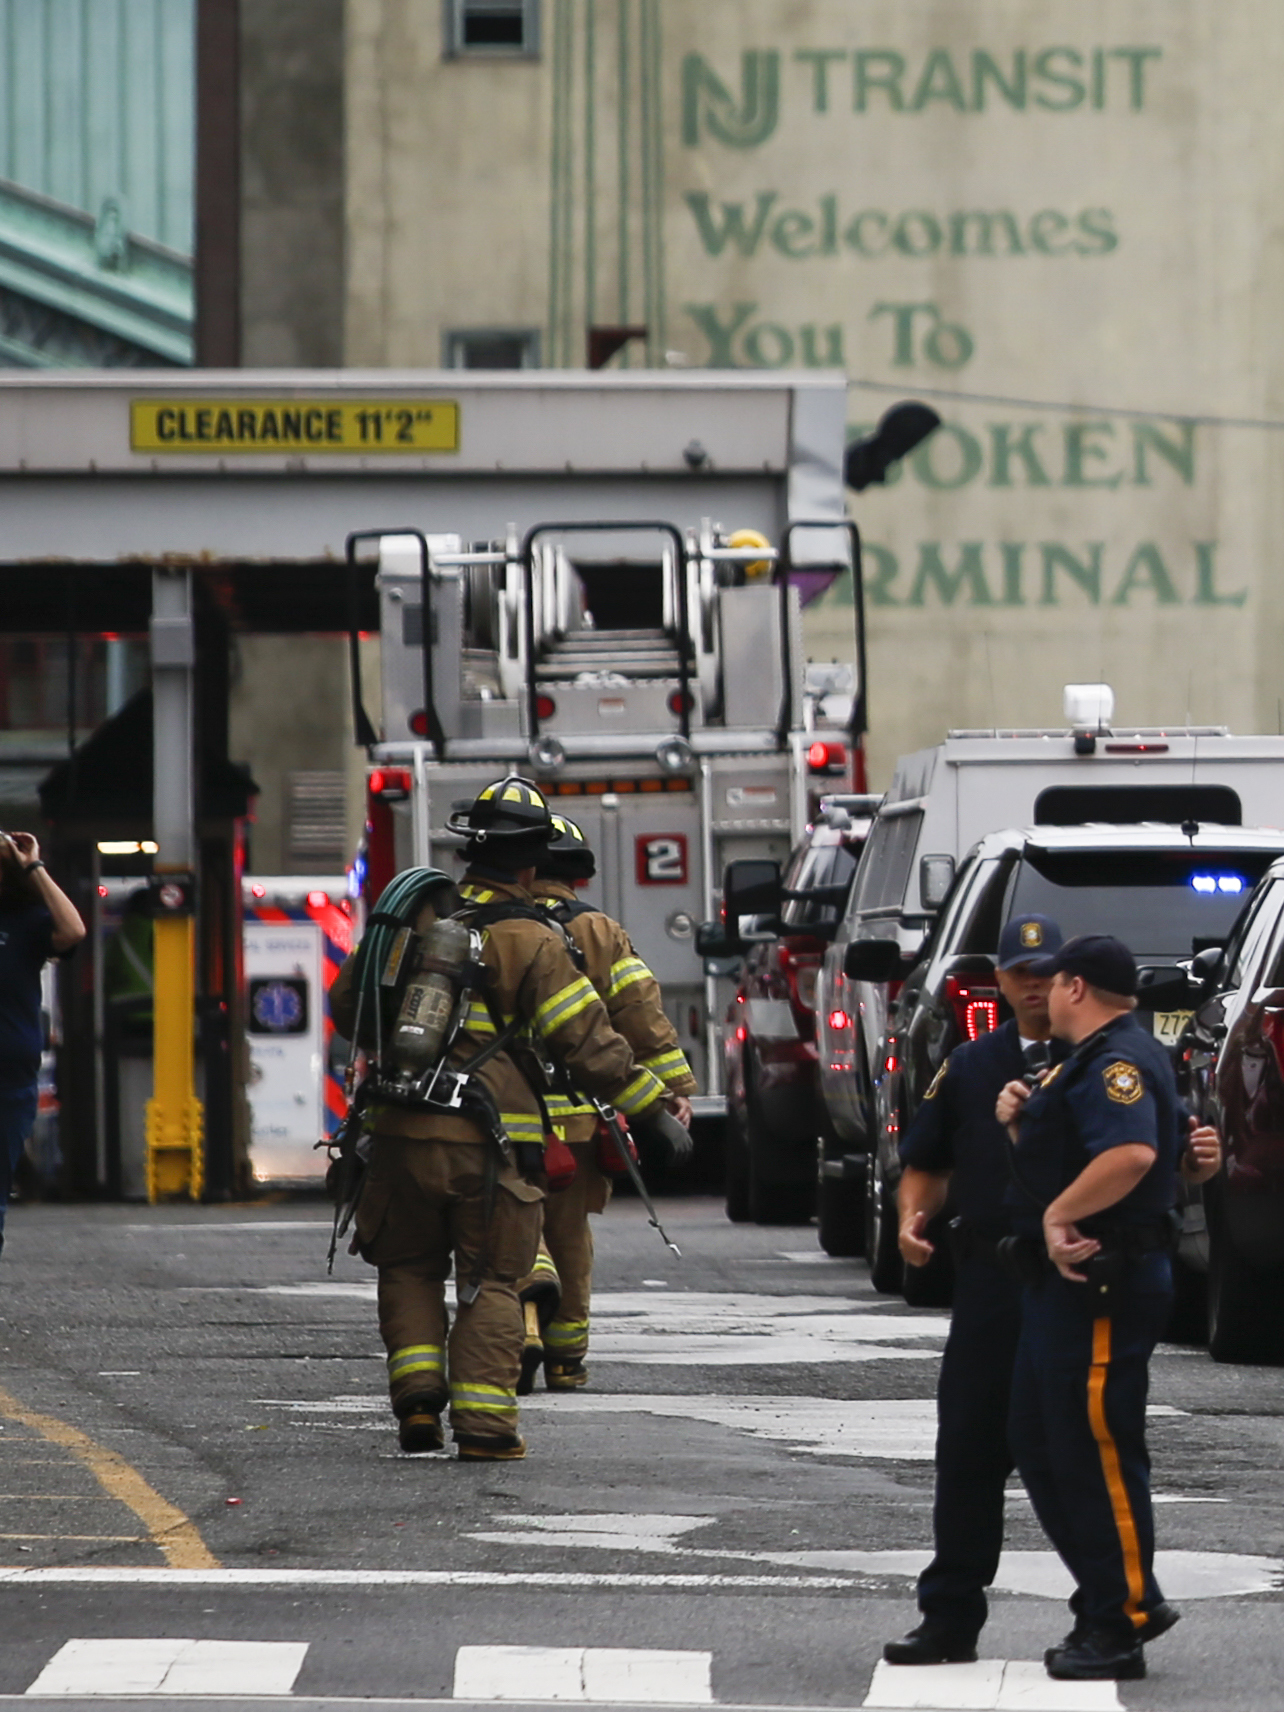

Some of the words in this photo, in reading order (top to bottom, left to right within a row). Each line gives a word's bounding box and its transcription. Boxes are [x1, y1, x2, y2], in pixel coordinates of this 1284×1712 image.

[681, 47, 781, 150] NJ
[793, 46, 1163, 114] TRANSIT
[682, 189, 1120, 259] Welcomes
[685, 302, 845, 368] You
[867, 301, 976, 369] To
[155, 408, 343, 443] CLEARANCE
[846, 422, 1198, 490] OKEN
[806, 540, 1247, 608] RMINAL
[646, 837, 683, 880] 2
